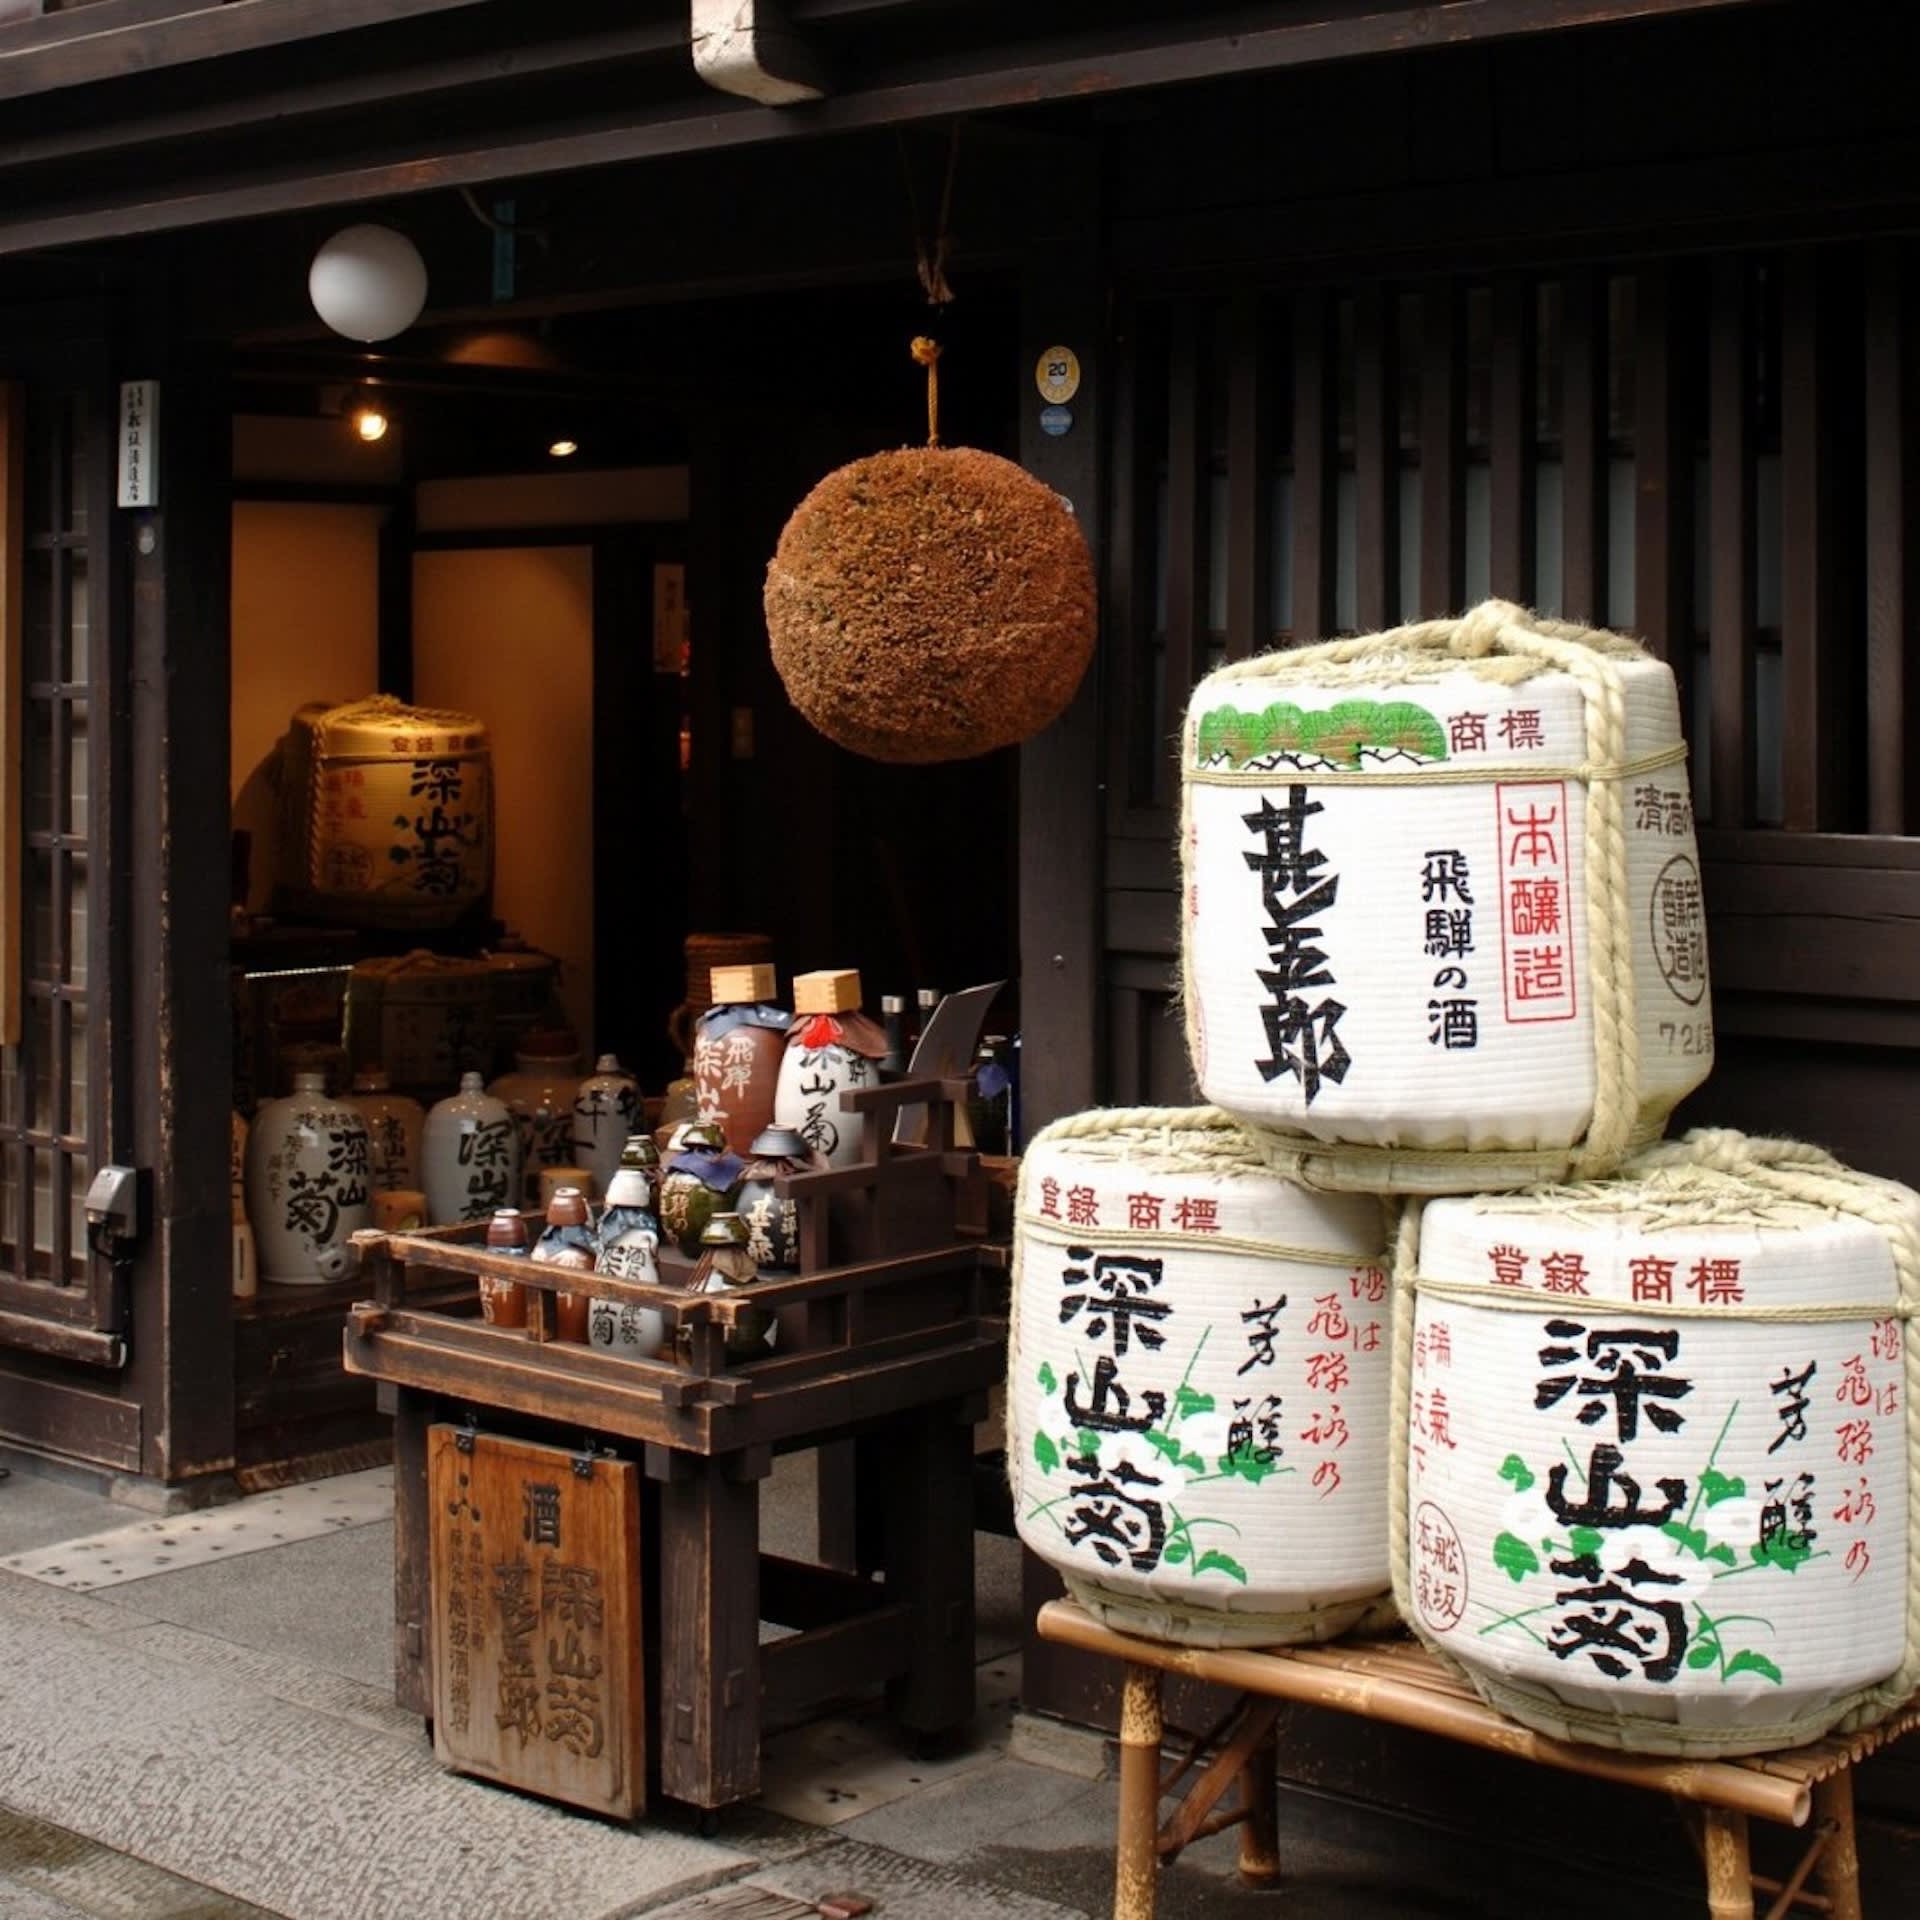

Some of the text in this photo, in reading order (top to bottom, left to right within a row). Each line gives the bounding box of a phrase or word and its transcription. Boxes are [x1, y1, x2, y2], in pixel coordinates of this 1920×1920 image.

[1048, 362, 1067, 377] 20
[1449, 708, 1546, 754] 商標
[1240, 784, 1352, 1106] 甚五郎
[1421, 848, 1478, 1050] 飛騨の酒
[328, 1129, 369, 1207] 深山
[1040, 1176, 1222, 1232] 登録 商標
[285, 1171, 340, 1244] 菊
[1488, 1245, 1746, 1304] 登録 商標
[1059, 1245, 1173, 1573] 深山菊
[523, 1482, 561, 1548] 酒
[1534, 1319, 1695, 1683] 深山菊
[491, 1558, 543, 1751] 甚五郎
[541, 1558, 604, 1759] 深山菊
